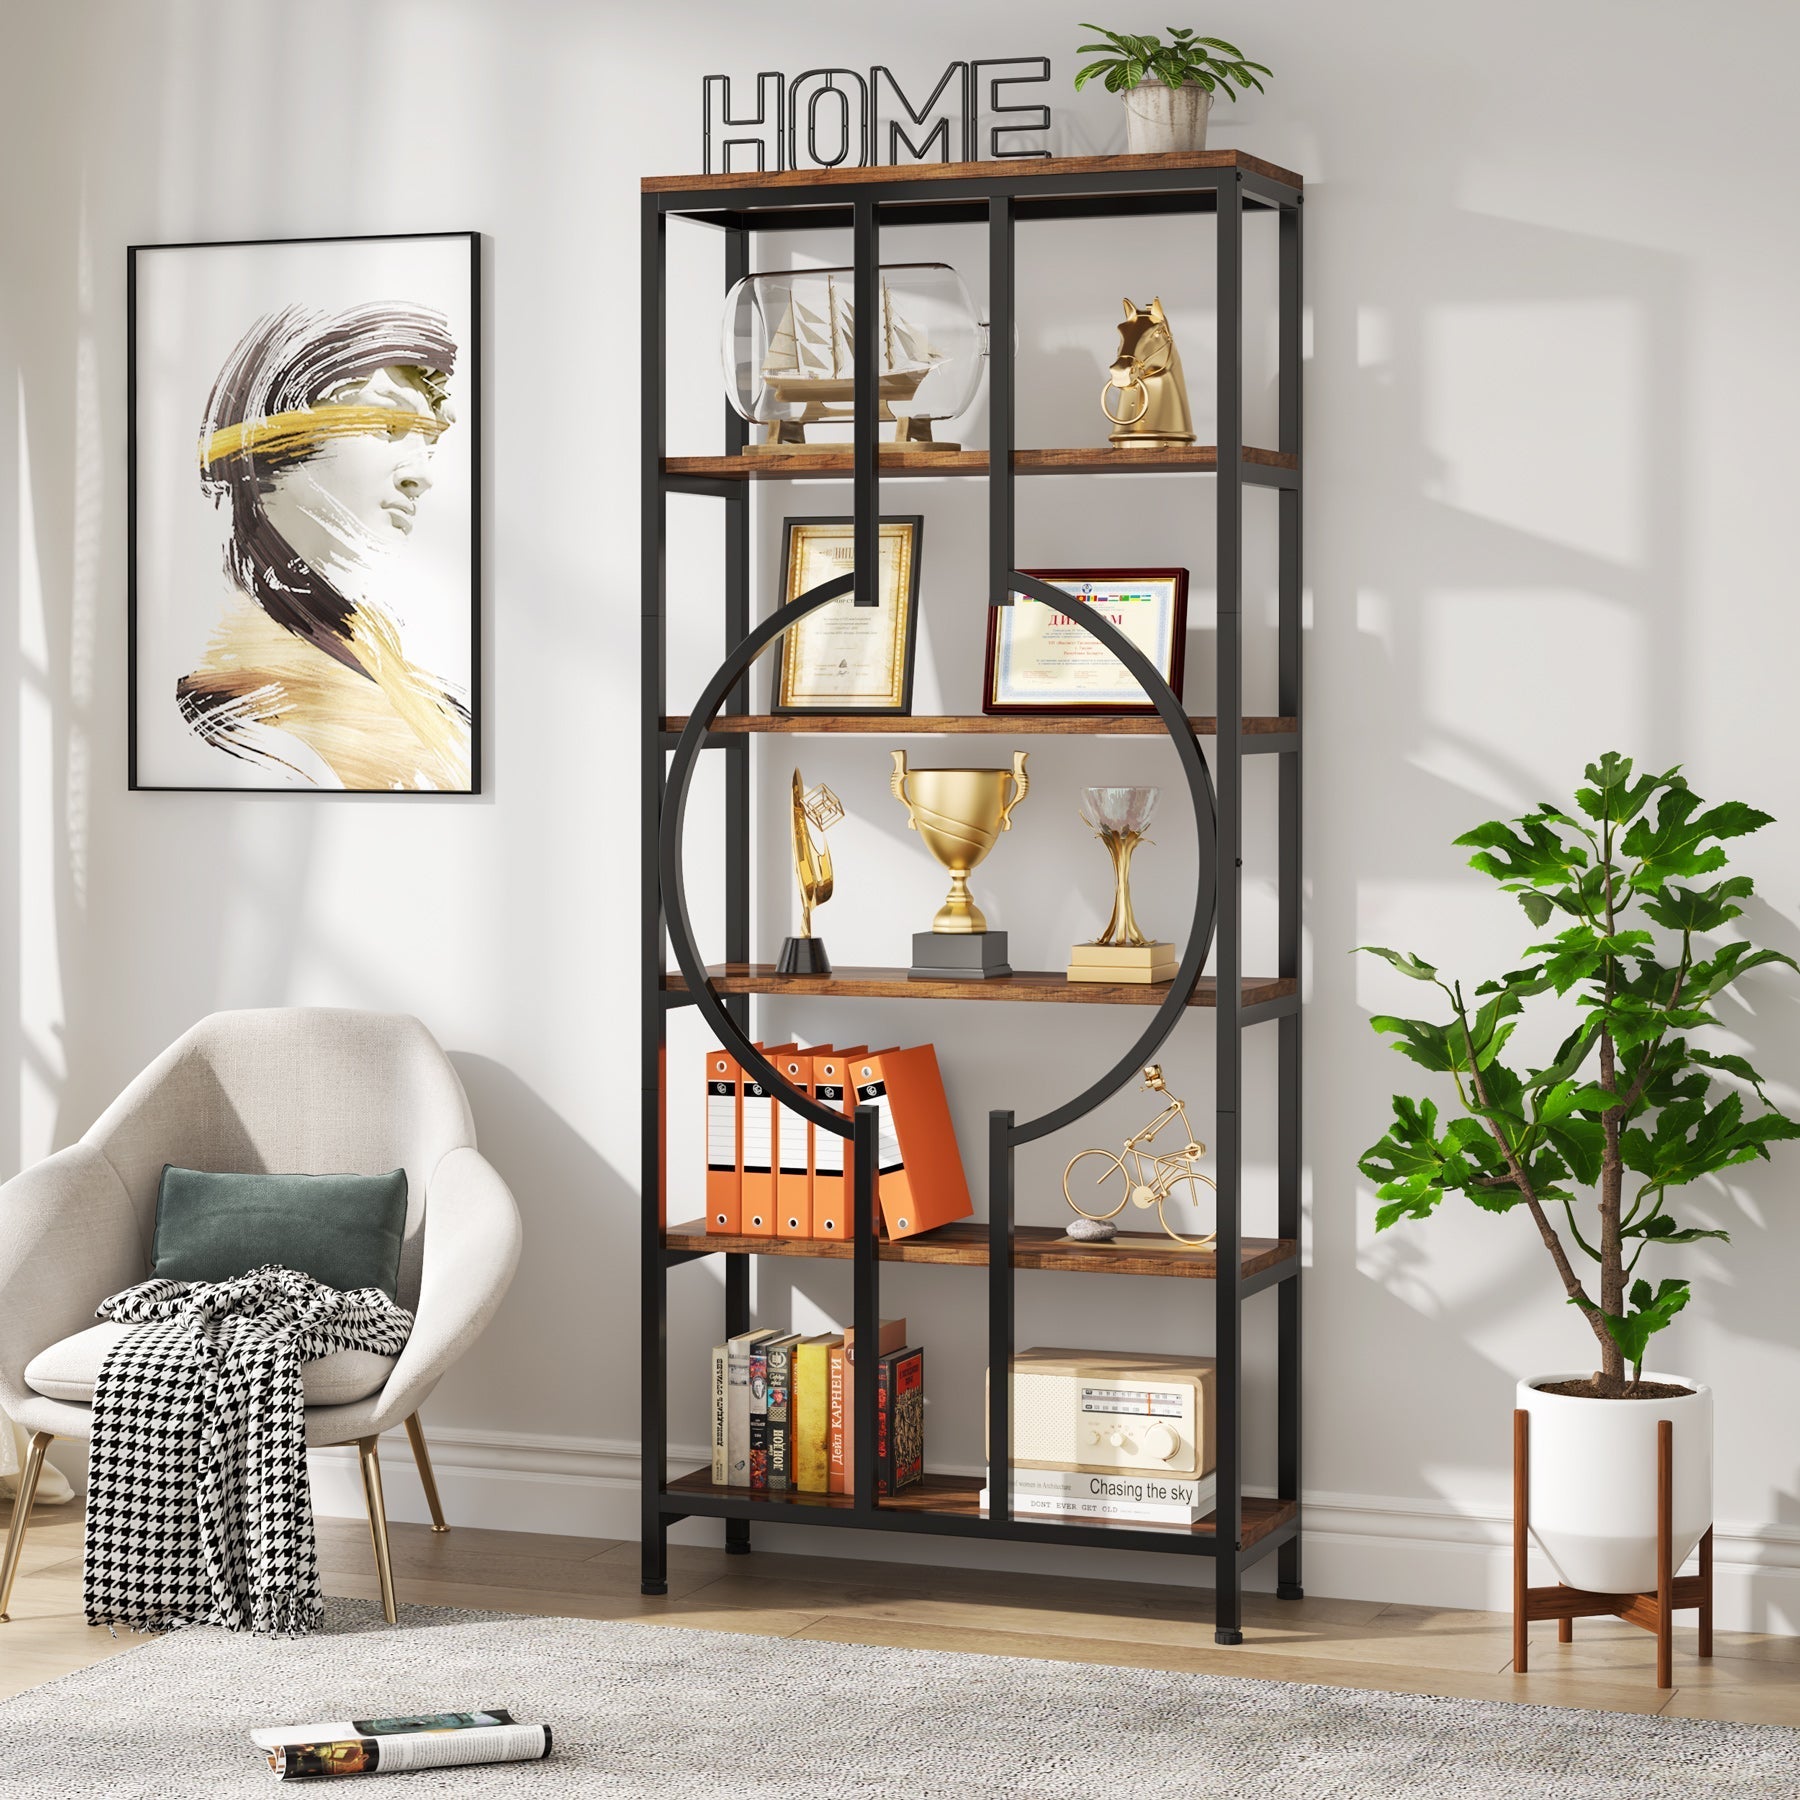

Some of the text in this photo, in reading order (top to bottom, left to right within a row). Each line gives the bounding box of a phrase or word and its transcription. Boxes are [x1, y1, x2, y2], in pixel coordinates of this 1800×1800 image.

[703, 56, 1051, 175] HOME
[1048, 614, 1122, 626] ДИМ
[831, 1357, 844, 1466] Дейл КАРНЕГИ
[773, 1429, 786, 1471] ЛОНДОН
[1030, 1500, 1051, 1509] DONT
[1056, 1502, 1077, 1511] EVER
[1081, 1504, 1098, 1512] GET
[1102, 1505, 1118, 1514] OLD
[1090, 1478, 1193, 1505] Chasing the sky
